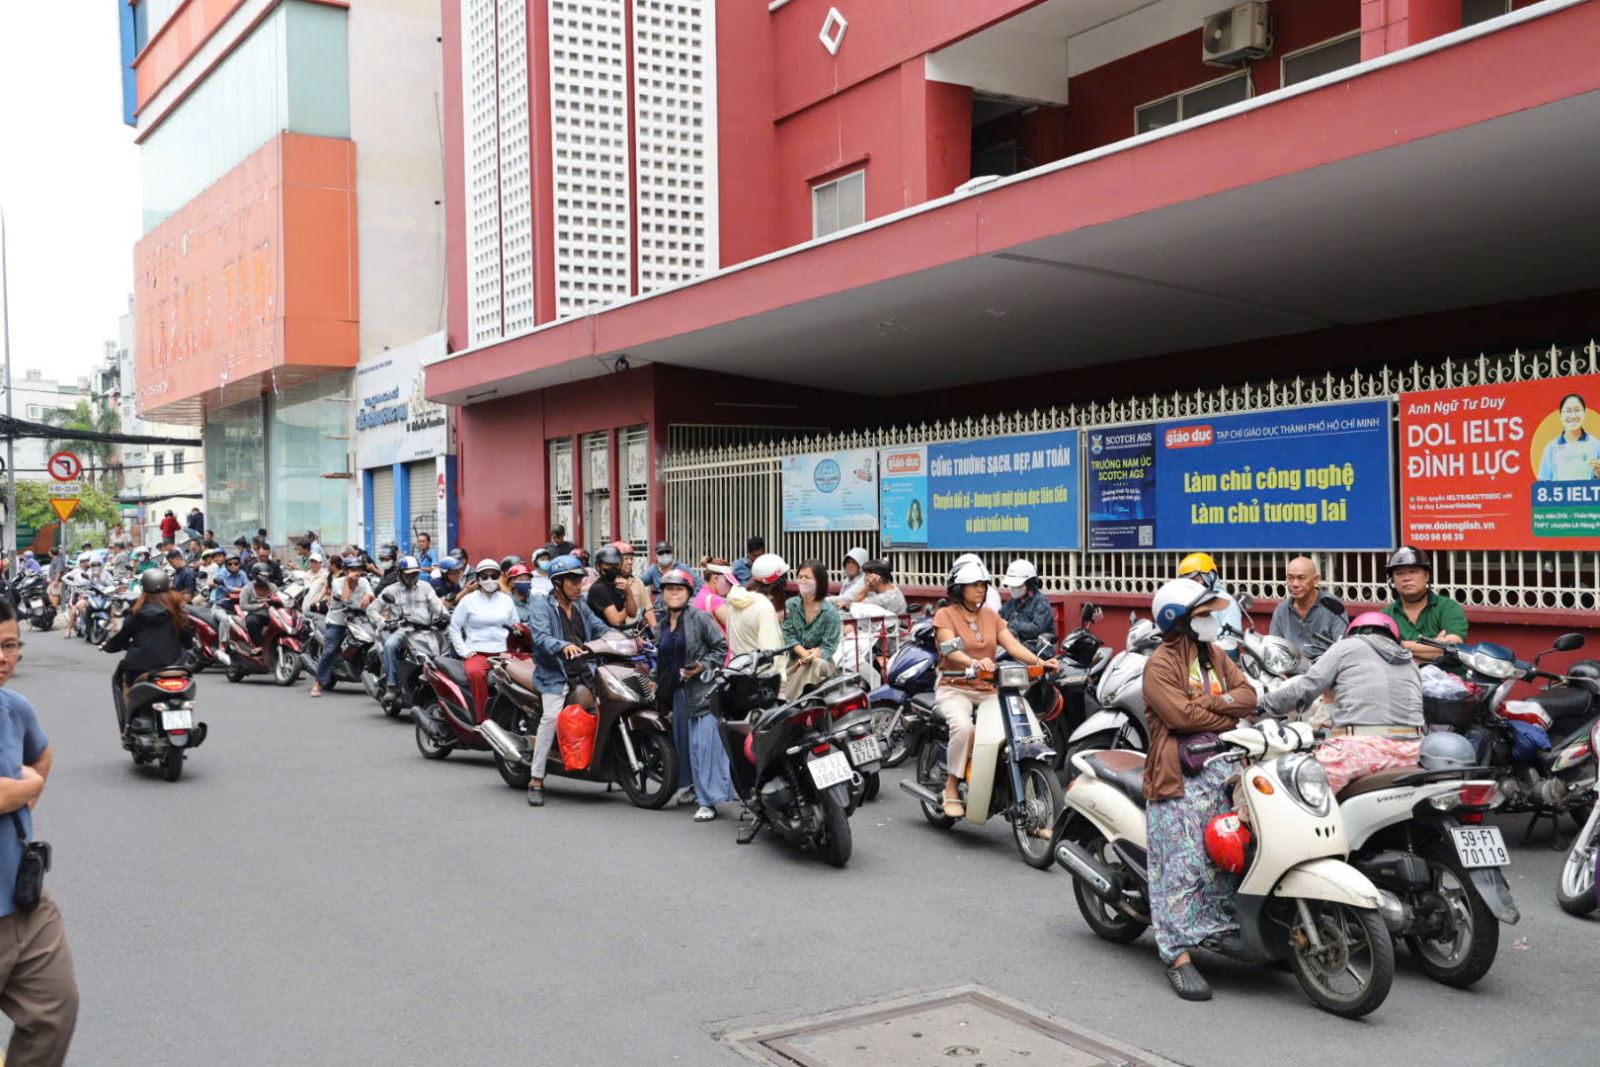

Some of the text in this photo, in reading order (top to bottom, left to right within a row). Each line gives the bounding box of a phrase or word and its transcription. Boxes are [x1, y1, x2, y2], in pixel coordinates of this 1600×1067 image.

[1408, 402, 1430, 415] Anh
[1462, 398, 1476, 410] Tư
[1480, 396, 1505, 409] Duy
[1166, 428, 1212, 446] giáo dục
[1217, 418, 1380, 440] TẠP CHÍ GIÁO DỤC THÀNH PHỐ HỒ CHÍ MINH
[1408, 416, 1524, 448] DOL IELTS
[1106, 432, 1152, 445] SCOTCH AGS
[954, 454, 986, 476] TRƯỜNG
[1032, 450, 1044, 469] AN
[1046, 444, 1070, 467] TOÀN
[1122, 457, 1138, 468] NAM
[1141, 455, 1152, 466] ÚC
[1408, 449, 1520, 480] ĐÌNH LỰC
[1099, 469, 1144, 480] SCOTCH AGS
[1184, 462, 1354, 493] Làm chủ công nghệ
[1537, 486, 1600, 502] 8.5 IELT
[1192, 498, 1346, 525] Làm chủ tương lai
[1410, 520, 1495, 531] www.dolenglish.vn
[1460, 831, 1495, 846] 59-F1
[1462, 849, 1507, 865] 701.19
